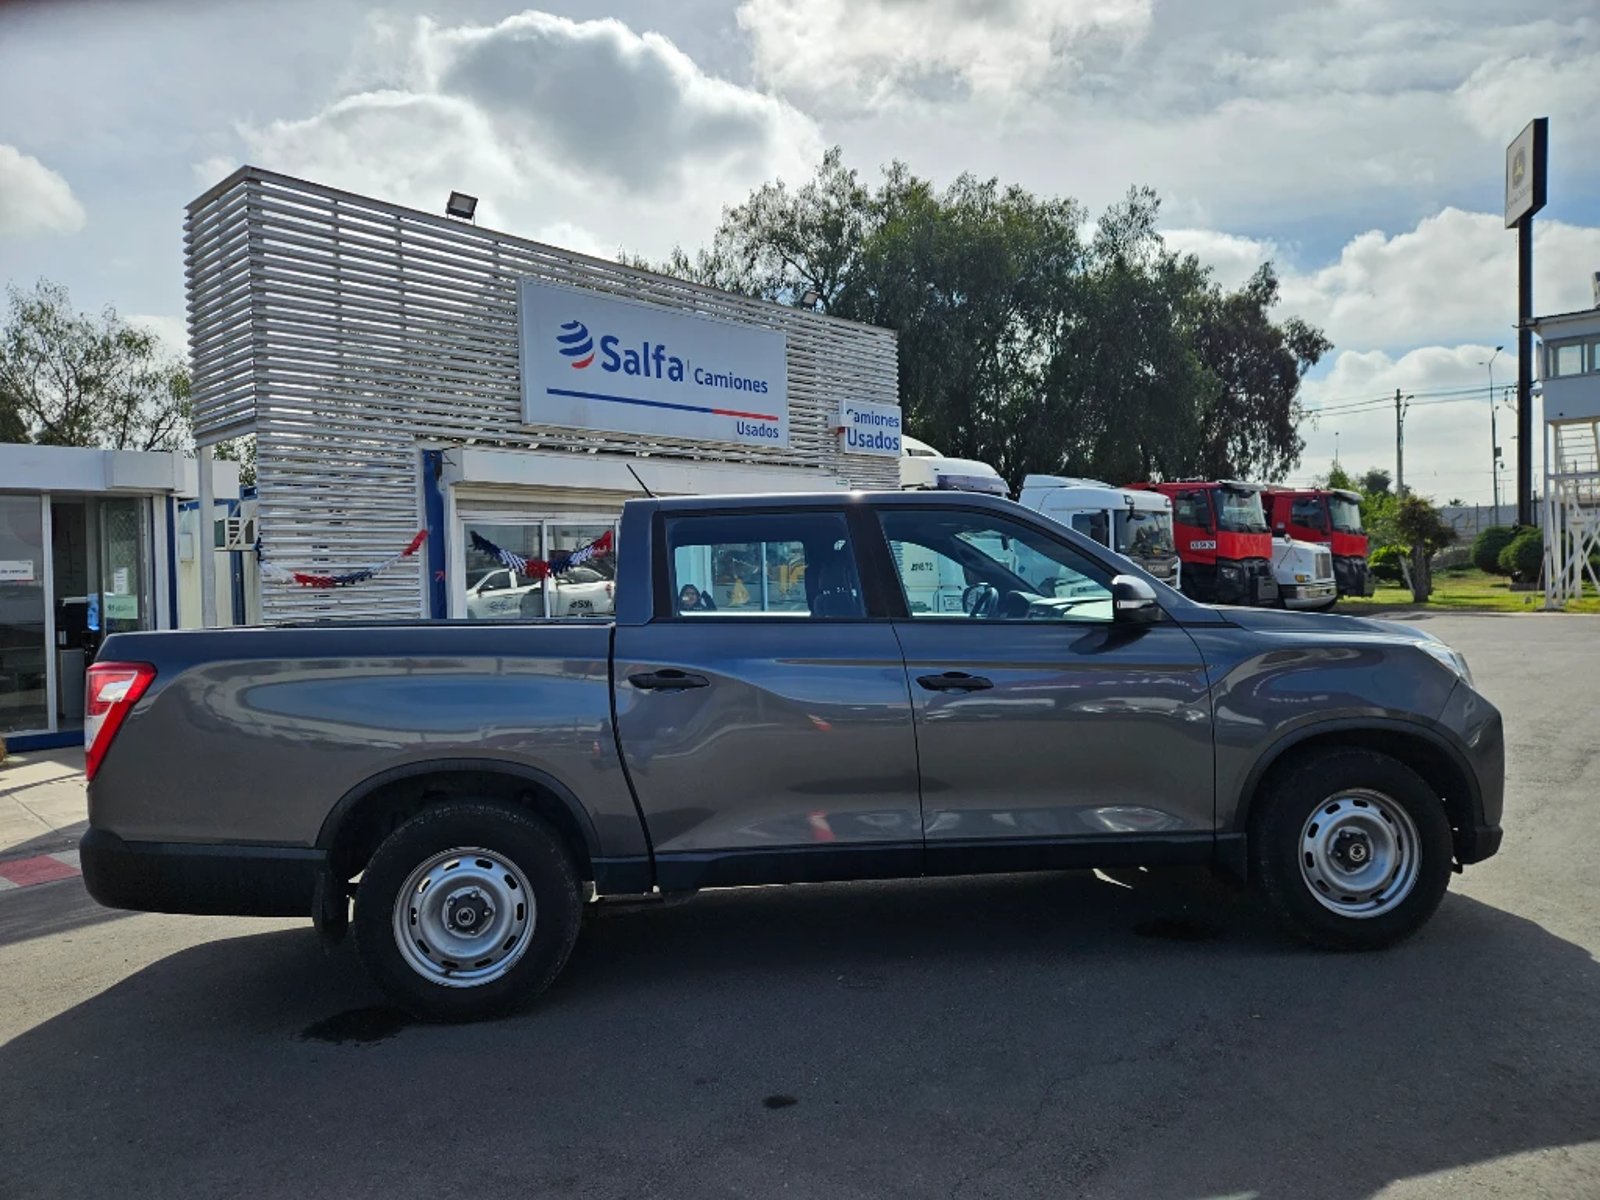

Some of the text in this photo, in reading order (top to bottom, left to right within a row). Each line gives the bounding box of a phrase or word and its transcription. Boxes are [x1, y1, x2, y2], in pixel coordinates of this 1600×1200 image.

[600, 335, 768, 393] Salfa Camiones
[736, 421, 779, 438] Usados
[847, 427, 900, 451] Usados
